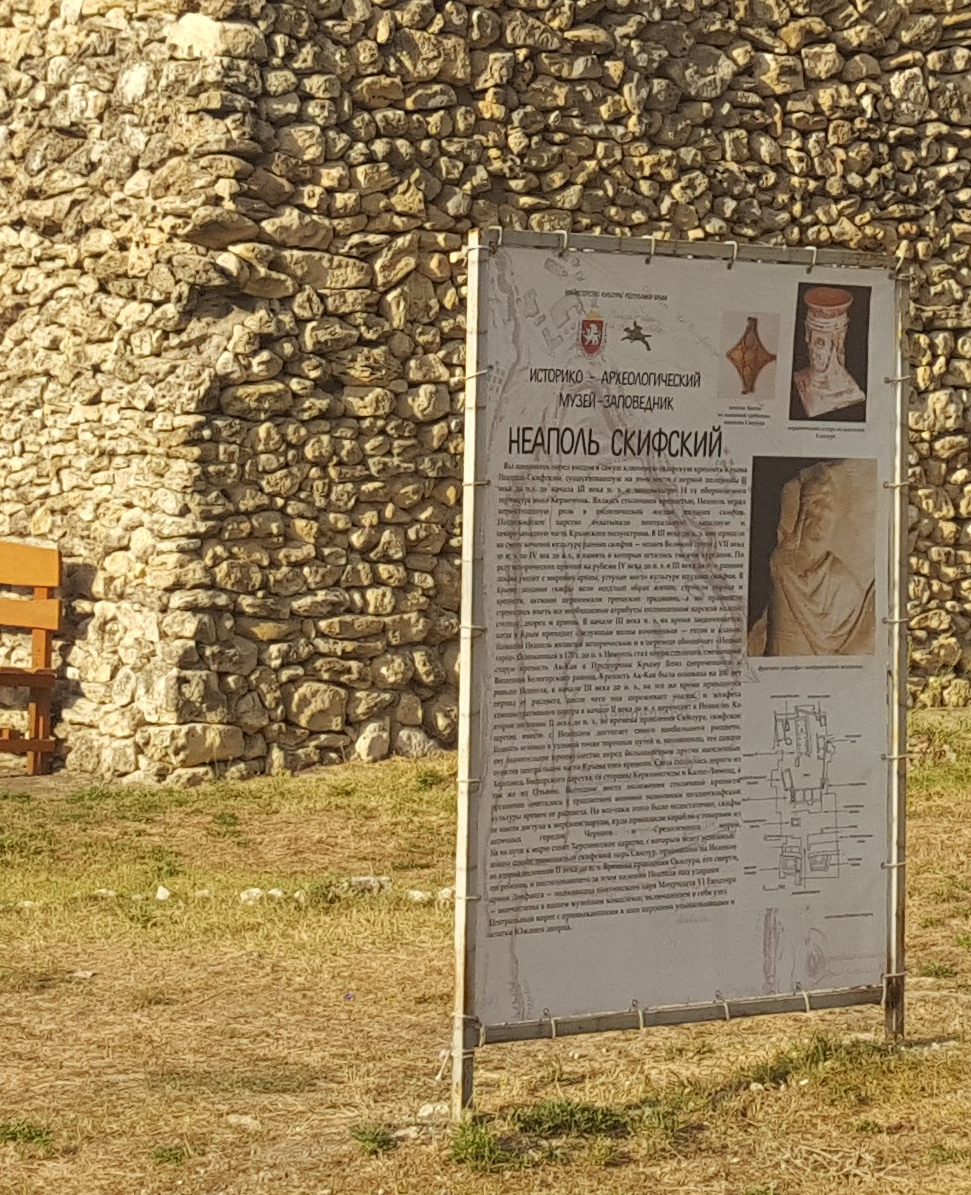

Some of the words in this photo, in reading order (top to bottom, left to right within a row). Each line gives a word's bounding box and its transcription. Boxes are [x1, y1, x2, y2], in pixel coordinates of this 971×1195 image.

[529, 368, 583, 384] ИСТОРИКО
[601, 371, 701, 388] АРХЕОЛОГИЧЕСКИЙ
[559, 392, 674, 412] МУЗЕЙ-ЗАПОВЕДНИК
[508, 426, 600, 455] НЕАПОЛЬ
[611, 425, 723, 457] СКИФСКИЙ
